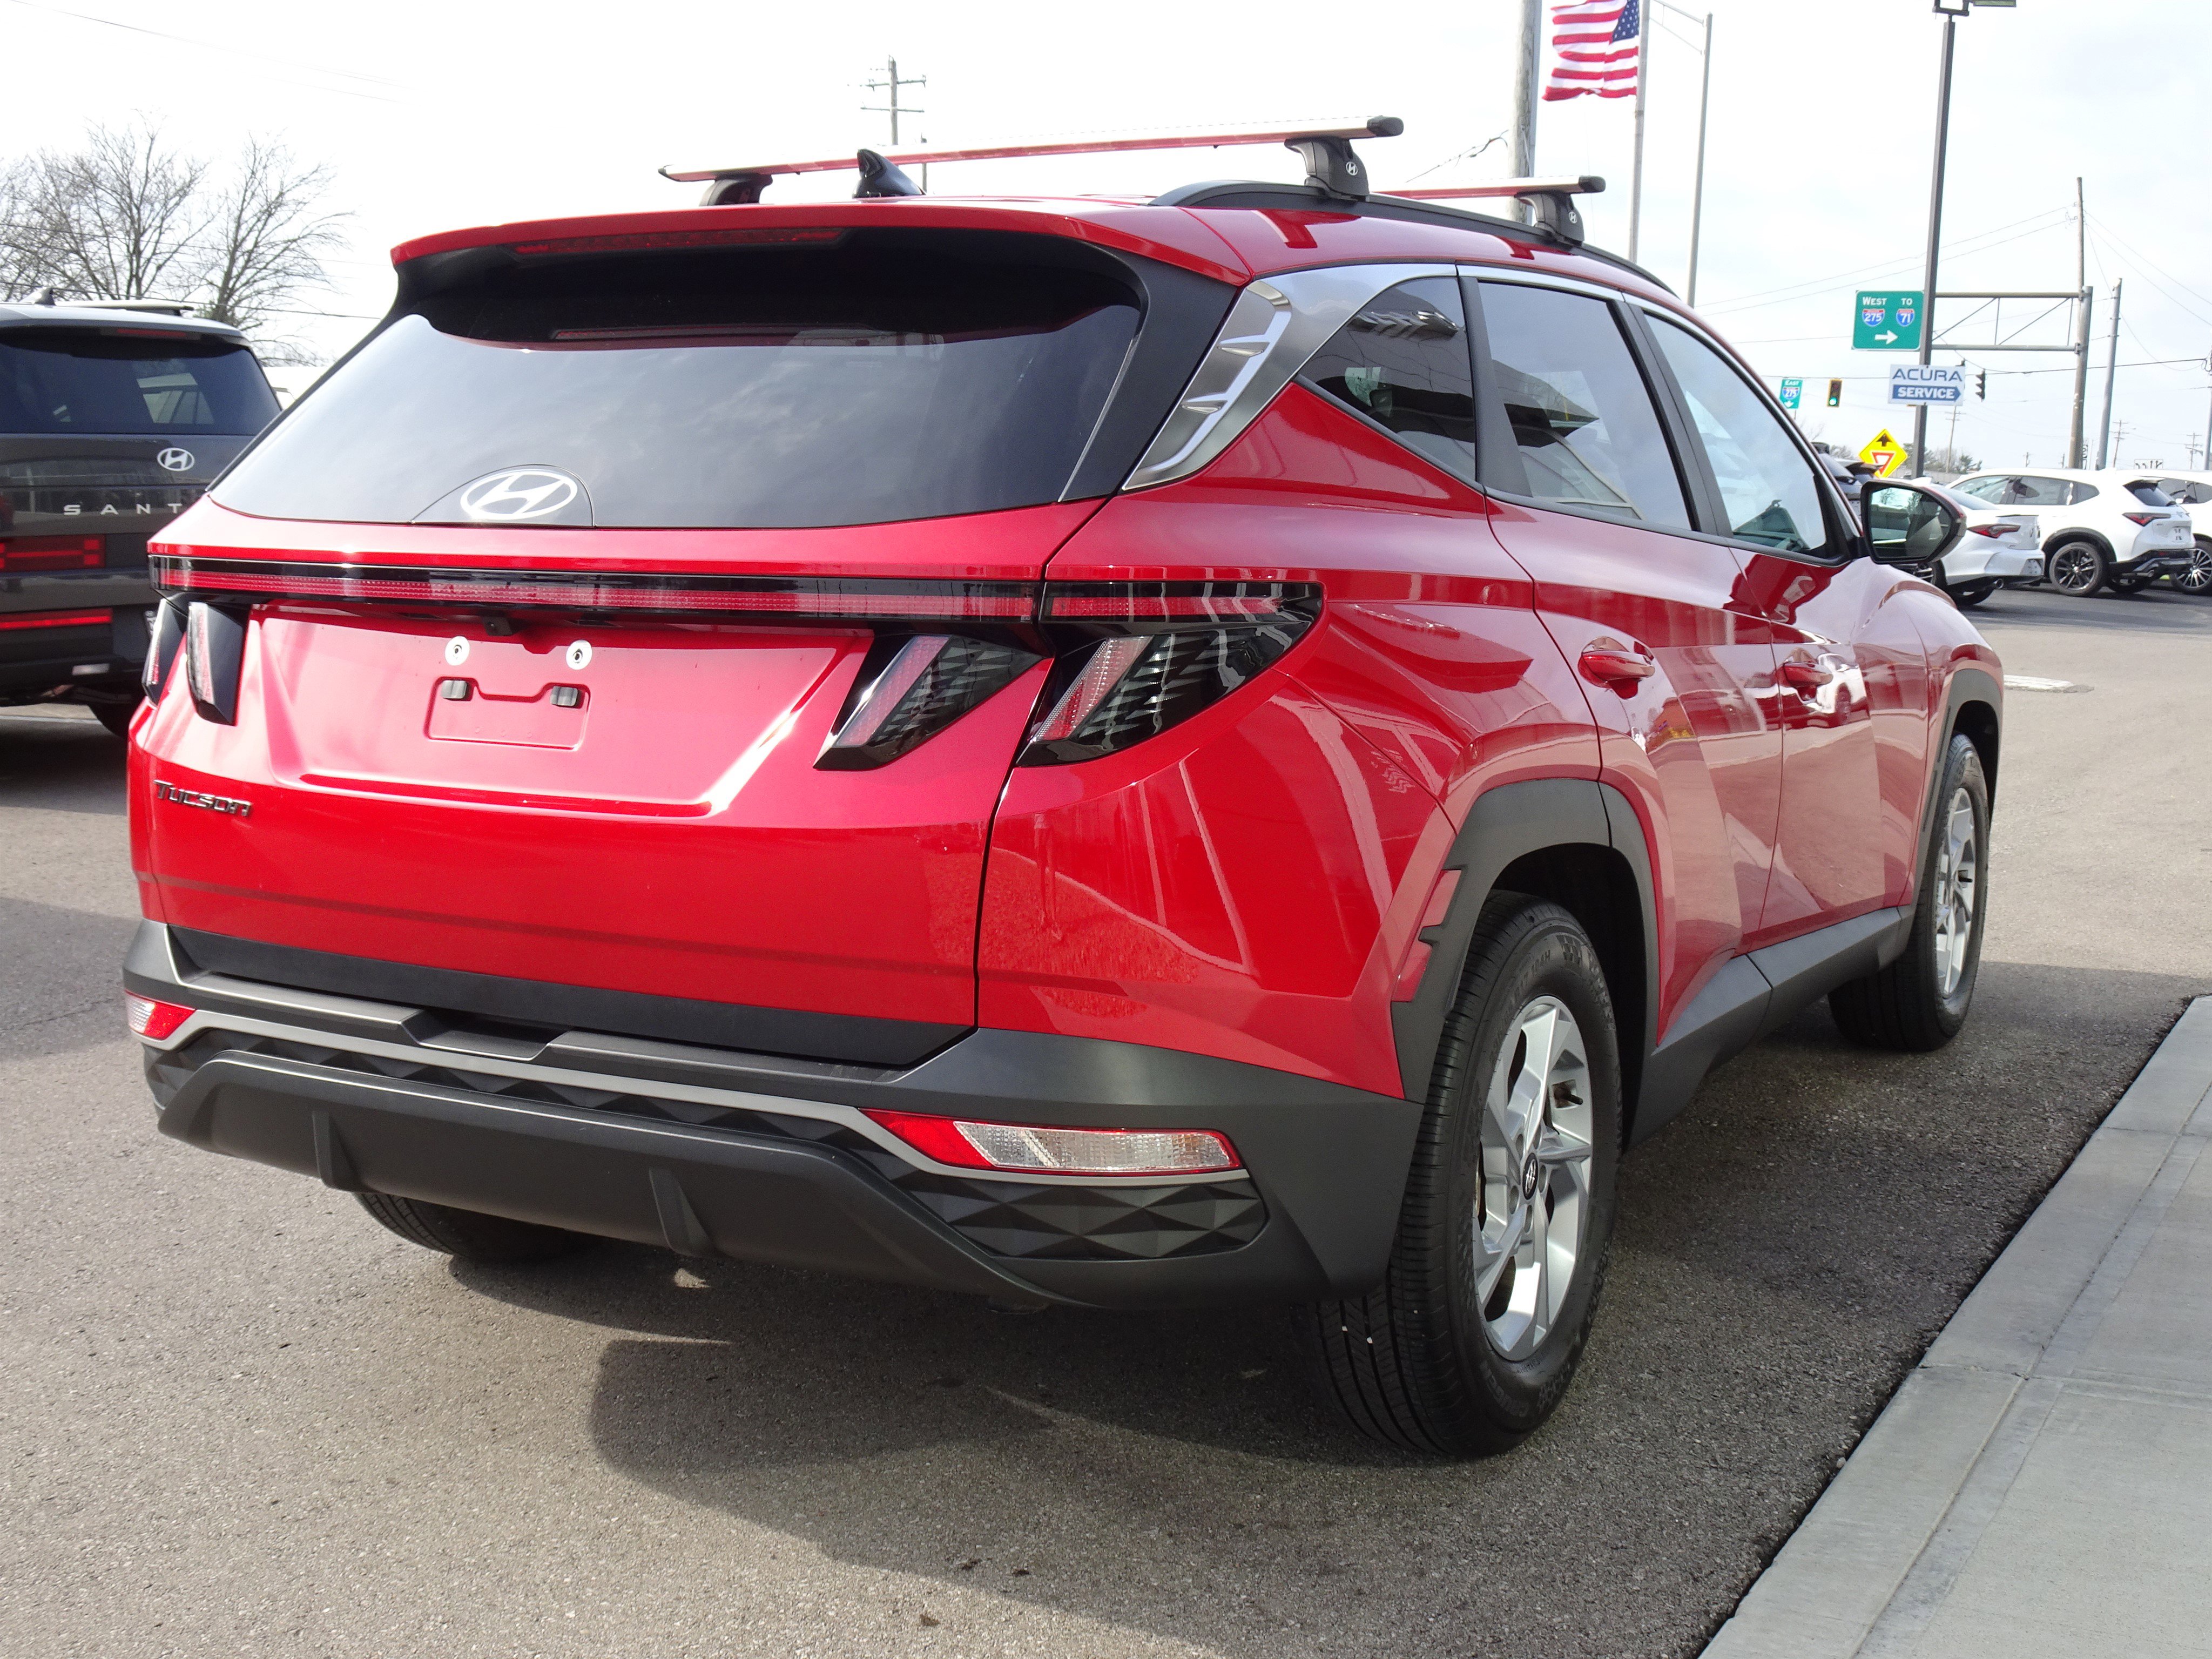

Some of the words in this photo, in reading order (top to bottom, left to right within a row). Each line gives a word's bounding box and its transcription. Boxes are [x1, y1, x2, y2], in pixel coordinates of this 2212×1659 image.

[1865, 314, 1881, 322] 275
[1900, 314, 1911, 323] 71
[1892, 368, 1963, 382] ACURA
[1898, 386, 1955, 399] SERVICE
